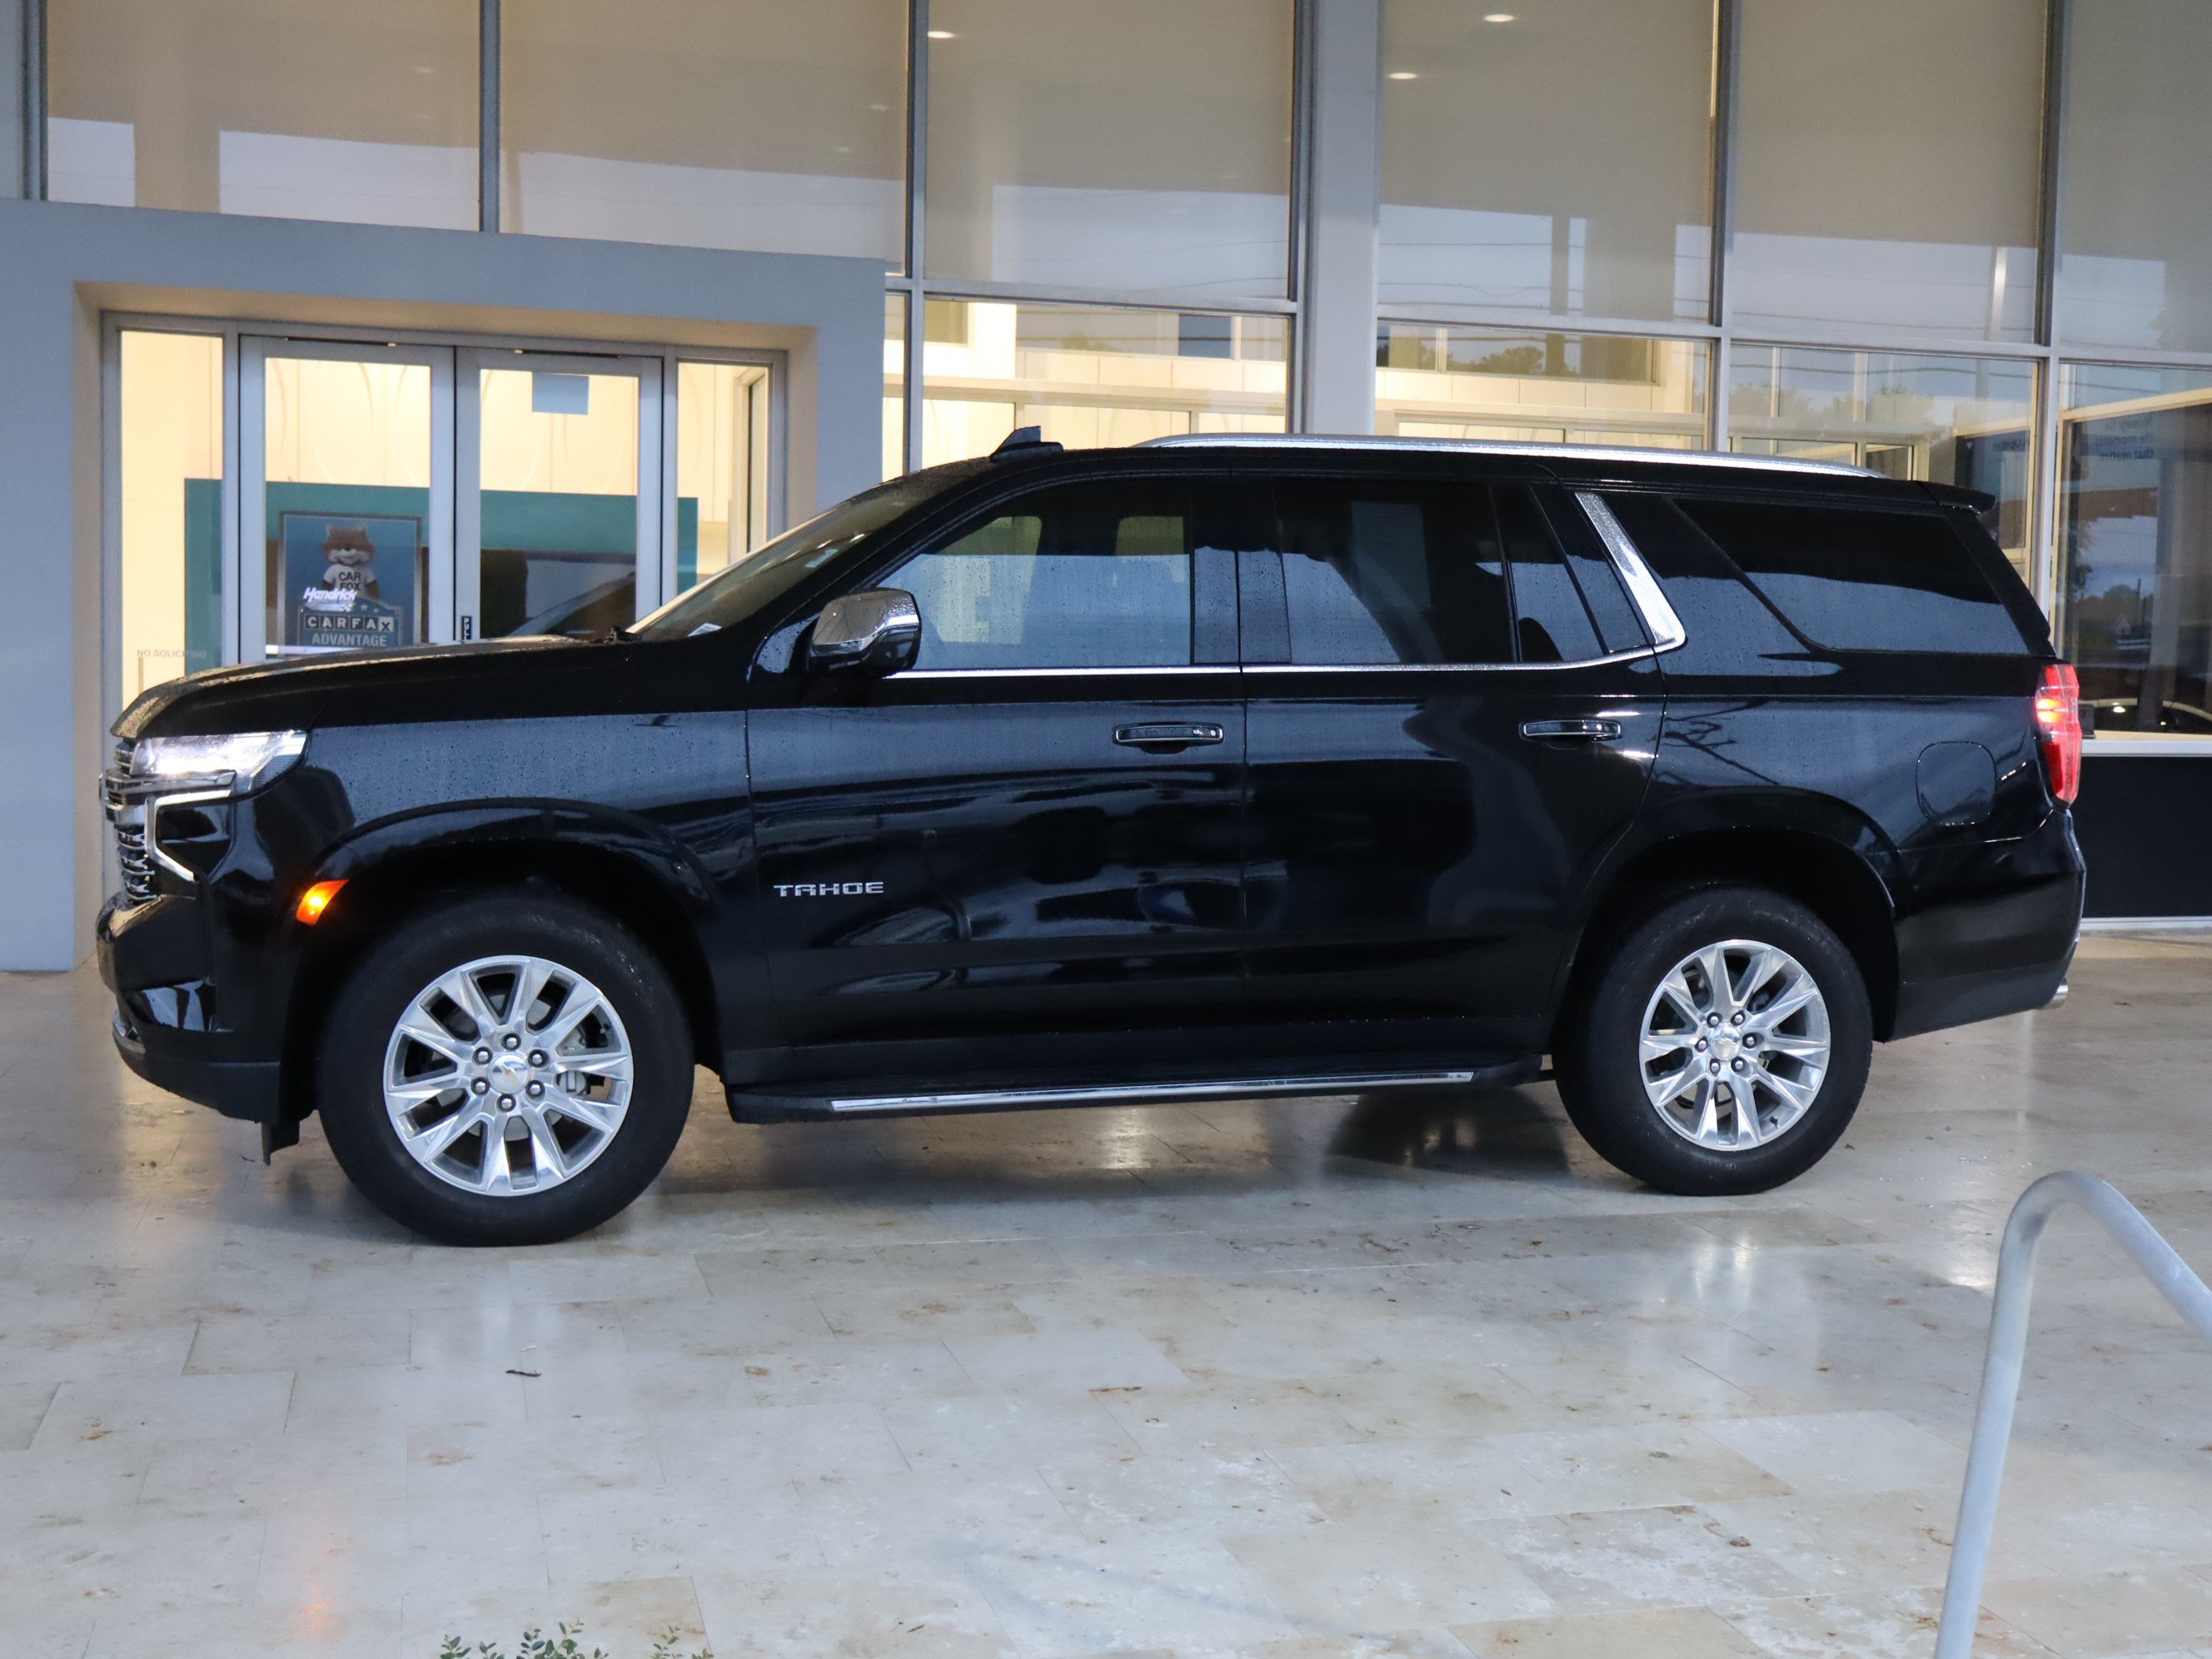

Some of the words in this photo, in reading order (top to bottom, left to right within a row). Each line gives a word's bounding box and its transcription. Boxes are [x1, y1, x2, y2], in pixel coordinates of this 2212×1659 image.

[339, 571, 361, 581] CAR
[340, 582, 360, 591] FOX
[306, 617, 391, 631] CARFAX
[311, 633, 386, 647] ADVANTAGE
[773, 881, 884, 897] TAHOE
